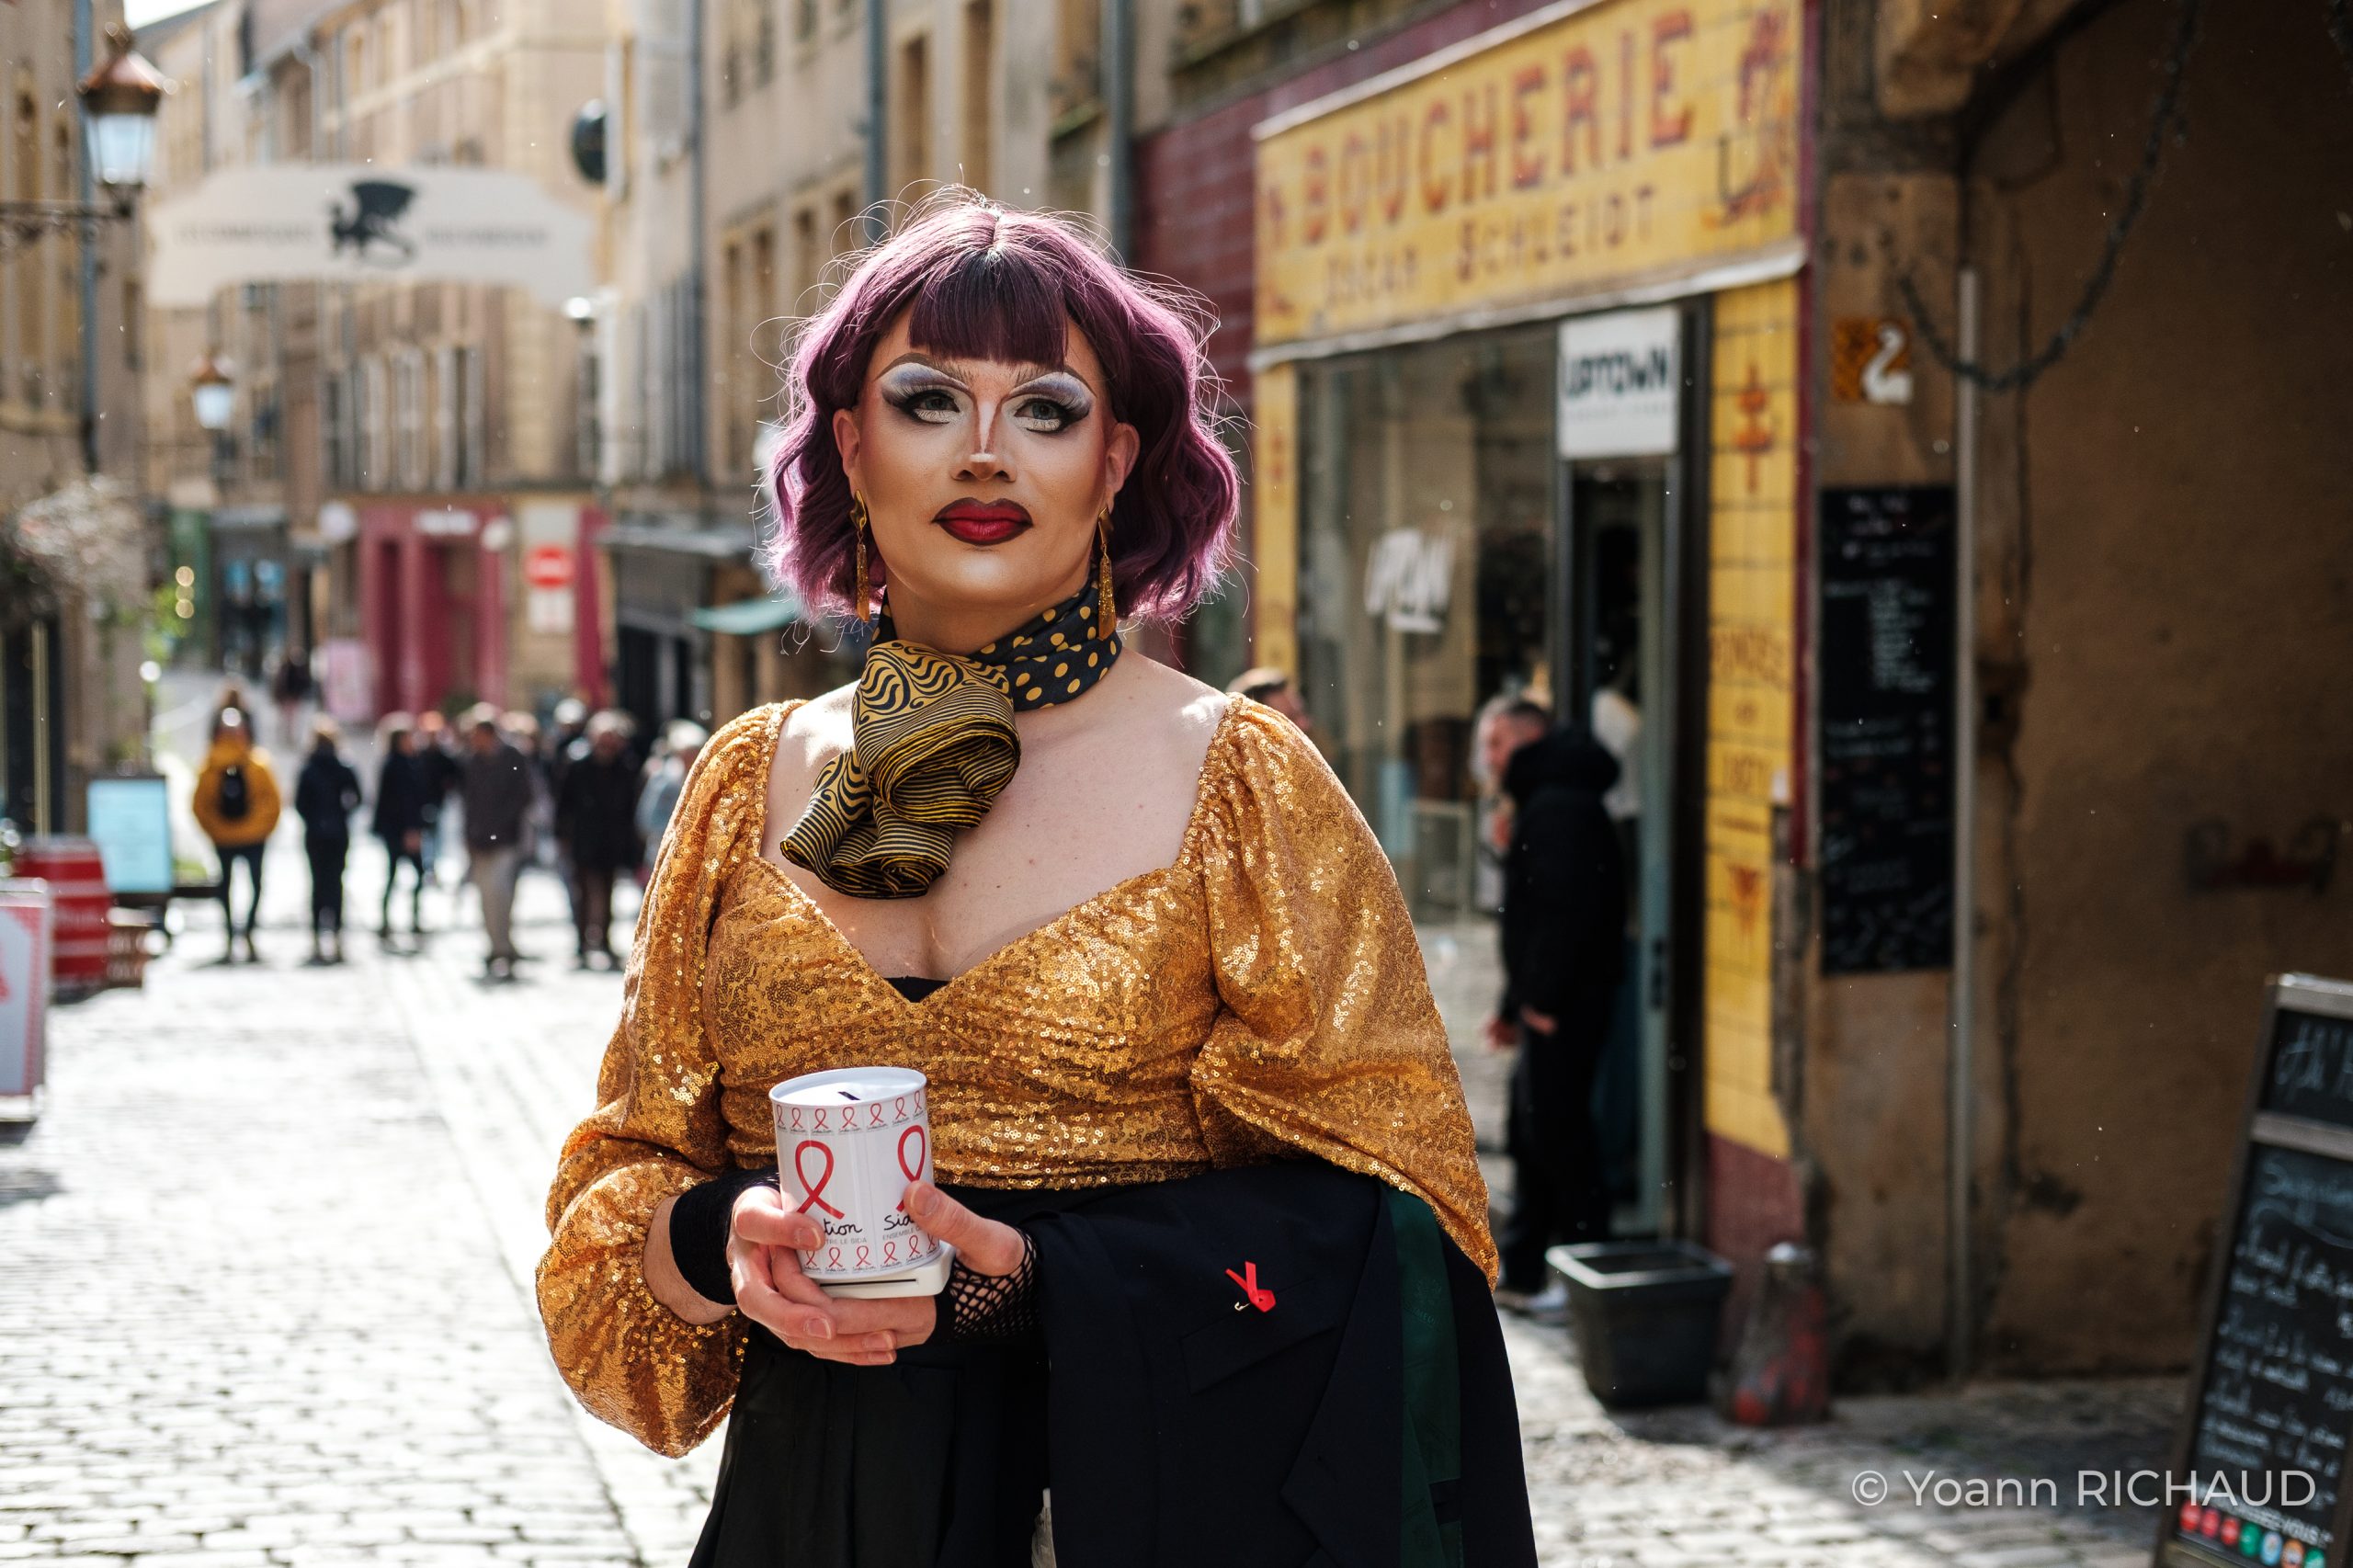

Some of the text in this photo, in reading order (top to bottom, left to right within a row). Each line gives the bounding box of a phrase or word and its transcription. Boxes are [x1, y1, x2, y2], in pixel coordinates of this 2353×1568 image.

[1302, 6, 1694, 245] BOUCHERIE
[1565, 347, 1668, 401] UPTOWN
[823, 1218, 862, 1236] tion
